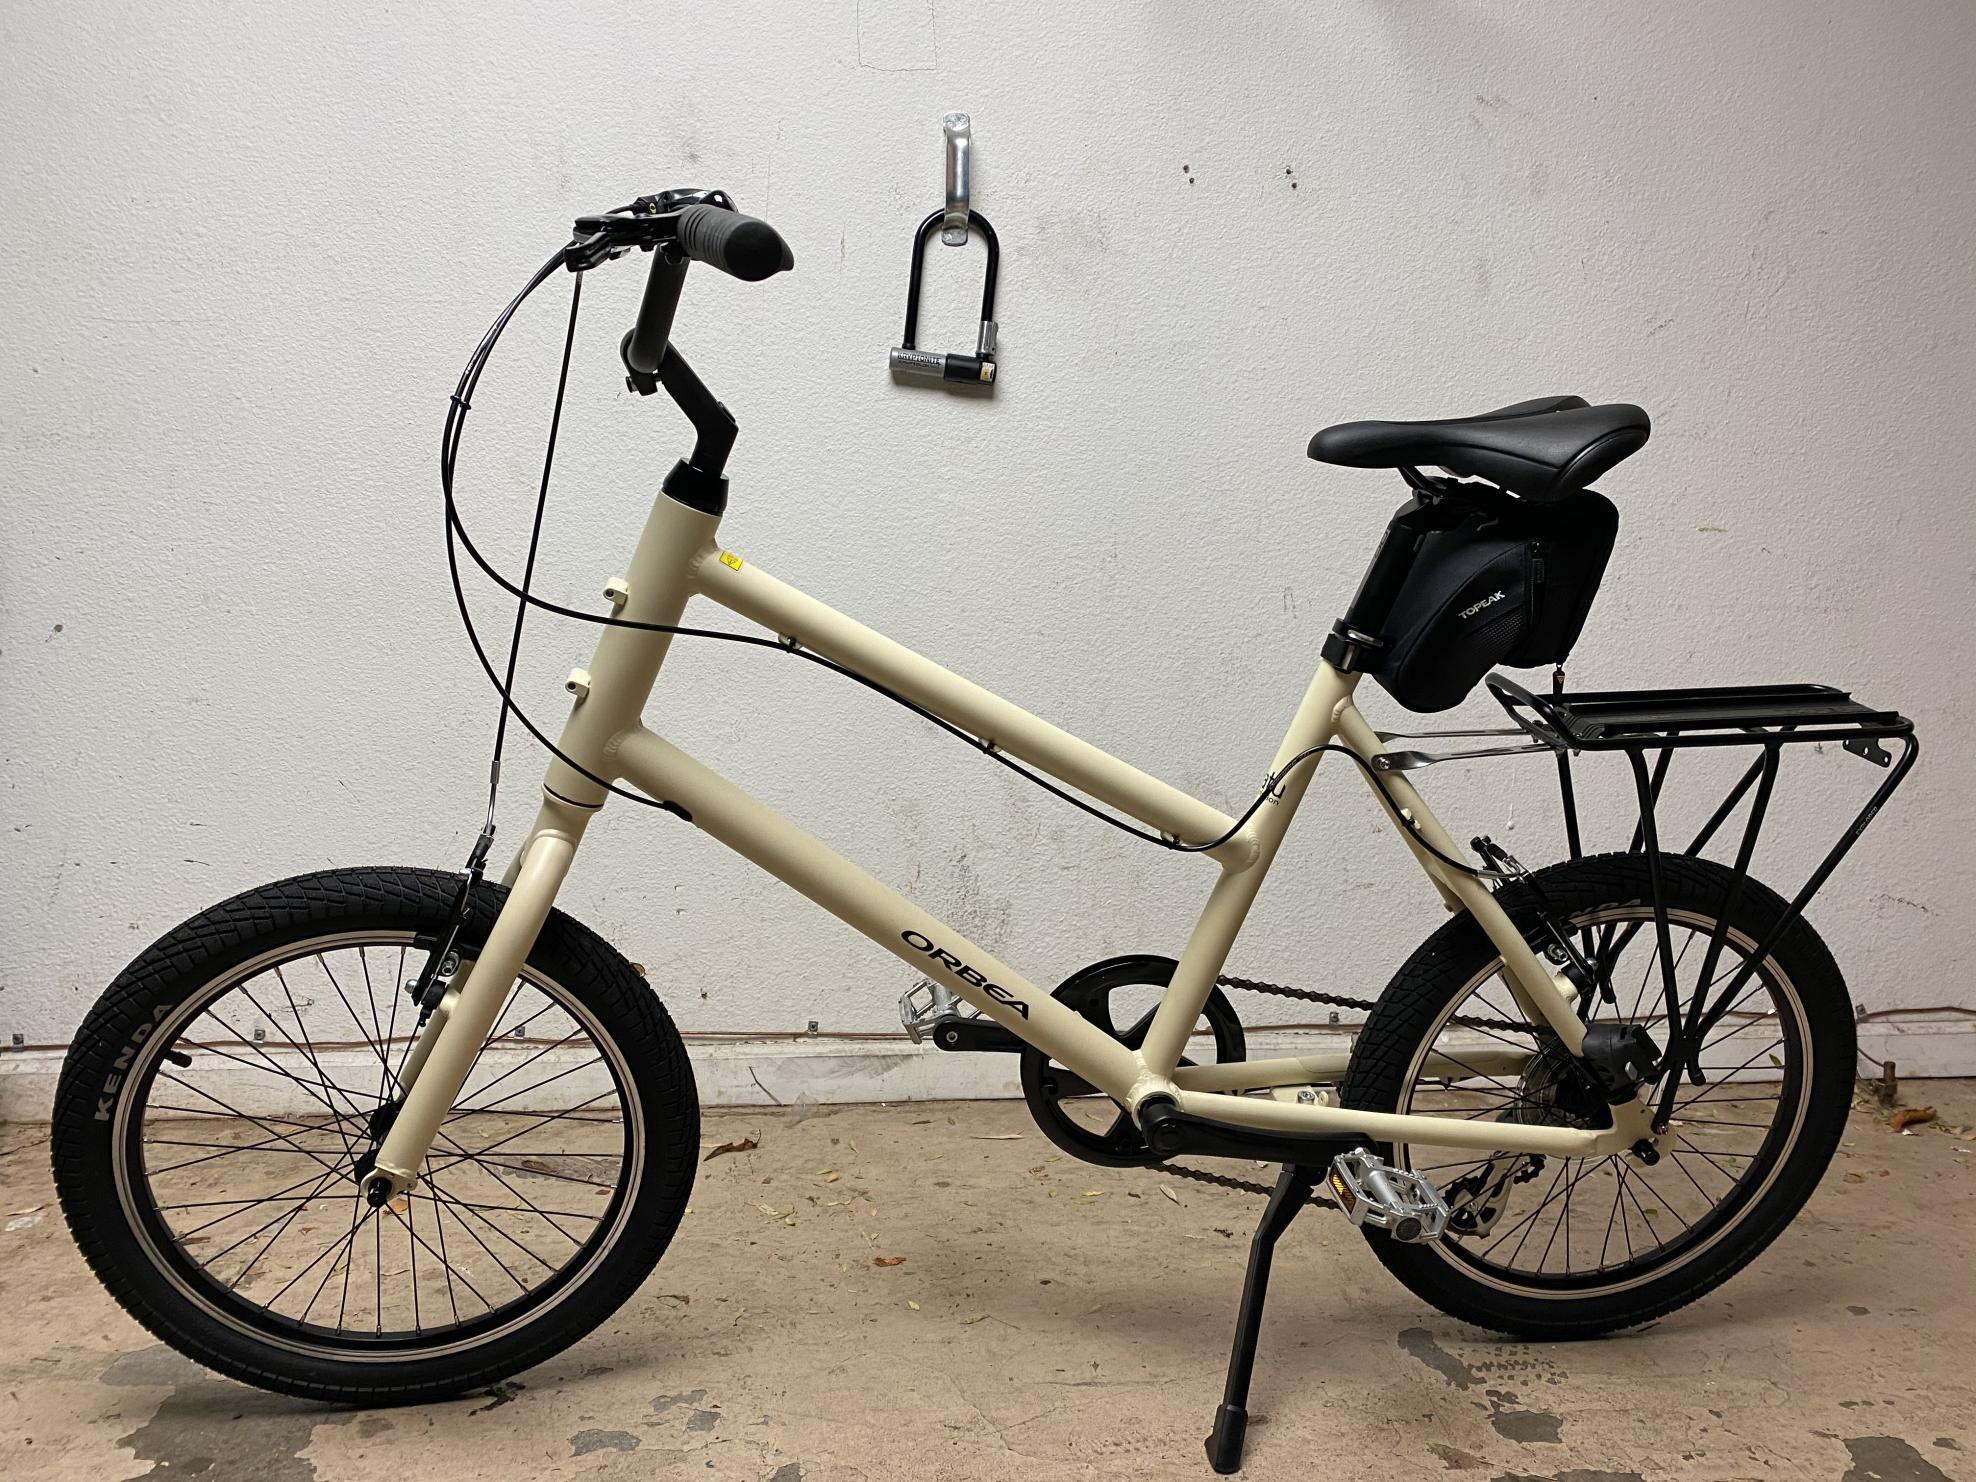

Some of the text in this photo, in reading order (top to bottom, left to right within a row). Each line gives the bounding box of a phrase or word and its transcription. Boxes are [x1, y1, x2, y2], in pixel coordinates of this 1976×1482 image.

[1458, 590, 1506, 619] TOPEAK
[901, 930, 1029, 1021] ORBEA
[94, 1004, 174, 1121] KENDA
